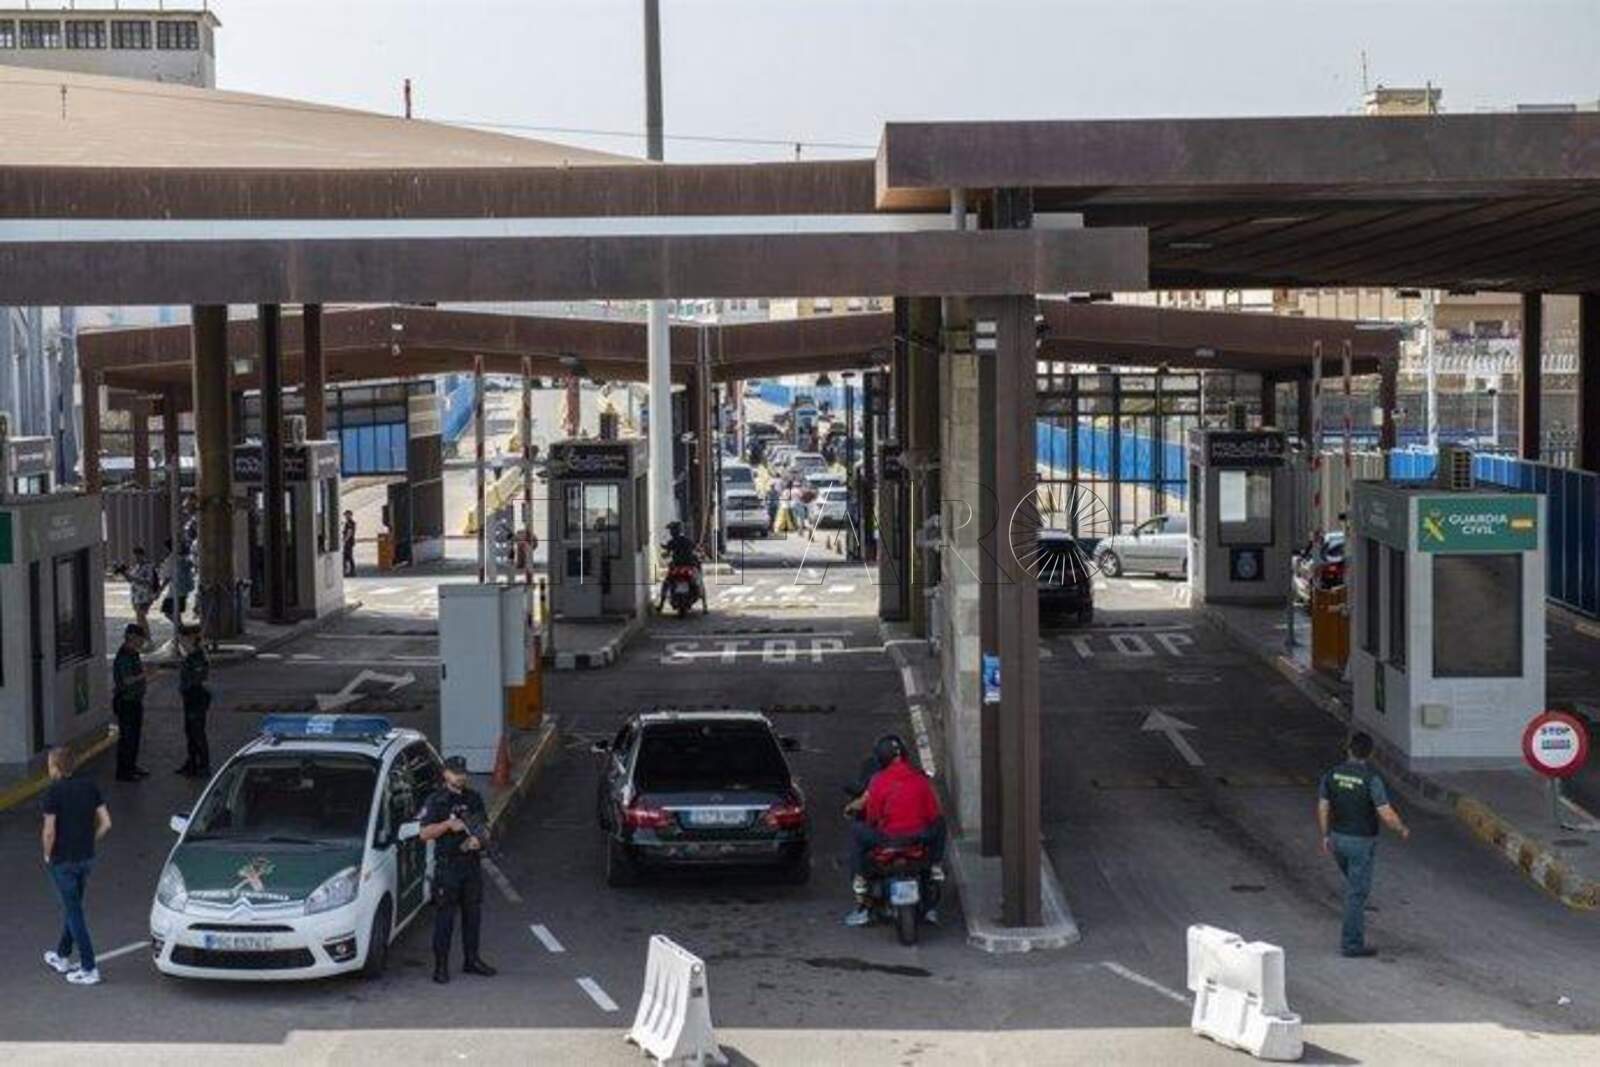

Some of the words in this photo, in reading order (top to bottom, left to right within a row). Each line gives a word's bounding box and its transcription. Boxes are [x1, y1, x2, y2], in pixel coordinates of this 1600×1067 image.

[1449, 513, 1507, 525] GUARDIA
[1462, 524, 1496, 535] CIVIL
[660, 639, 845, 664] STOP
[1542, 727, 1570, 736] STOP
